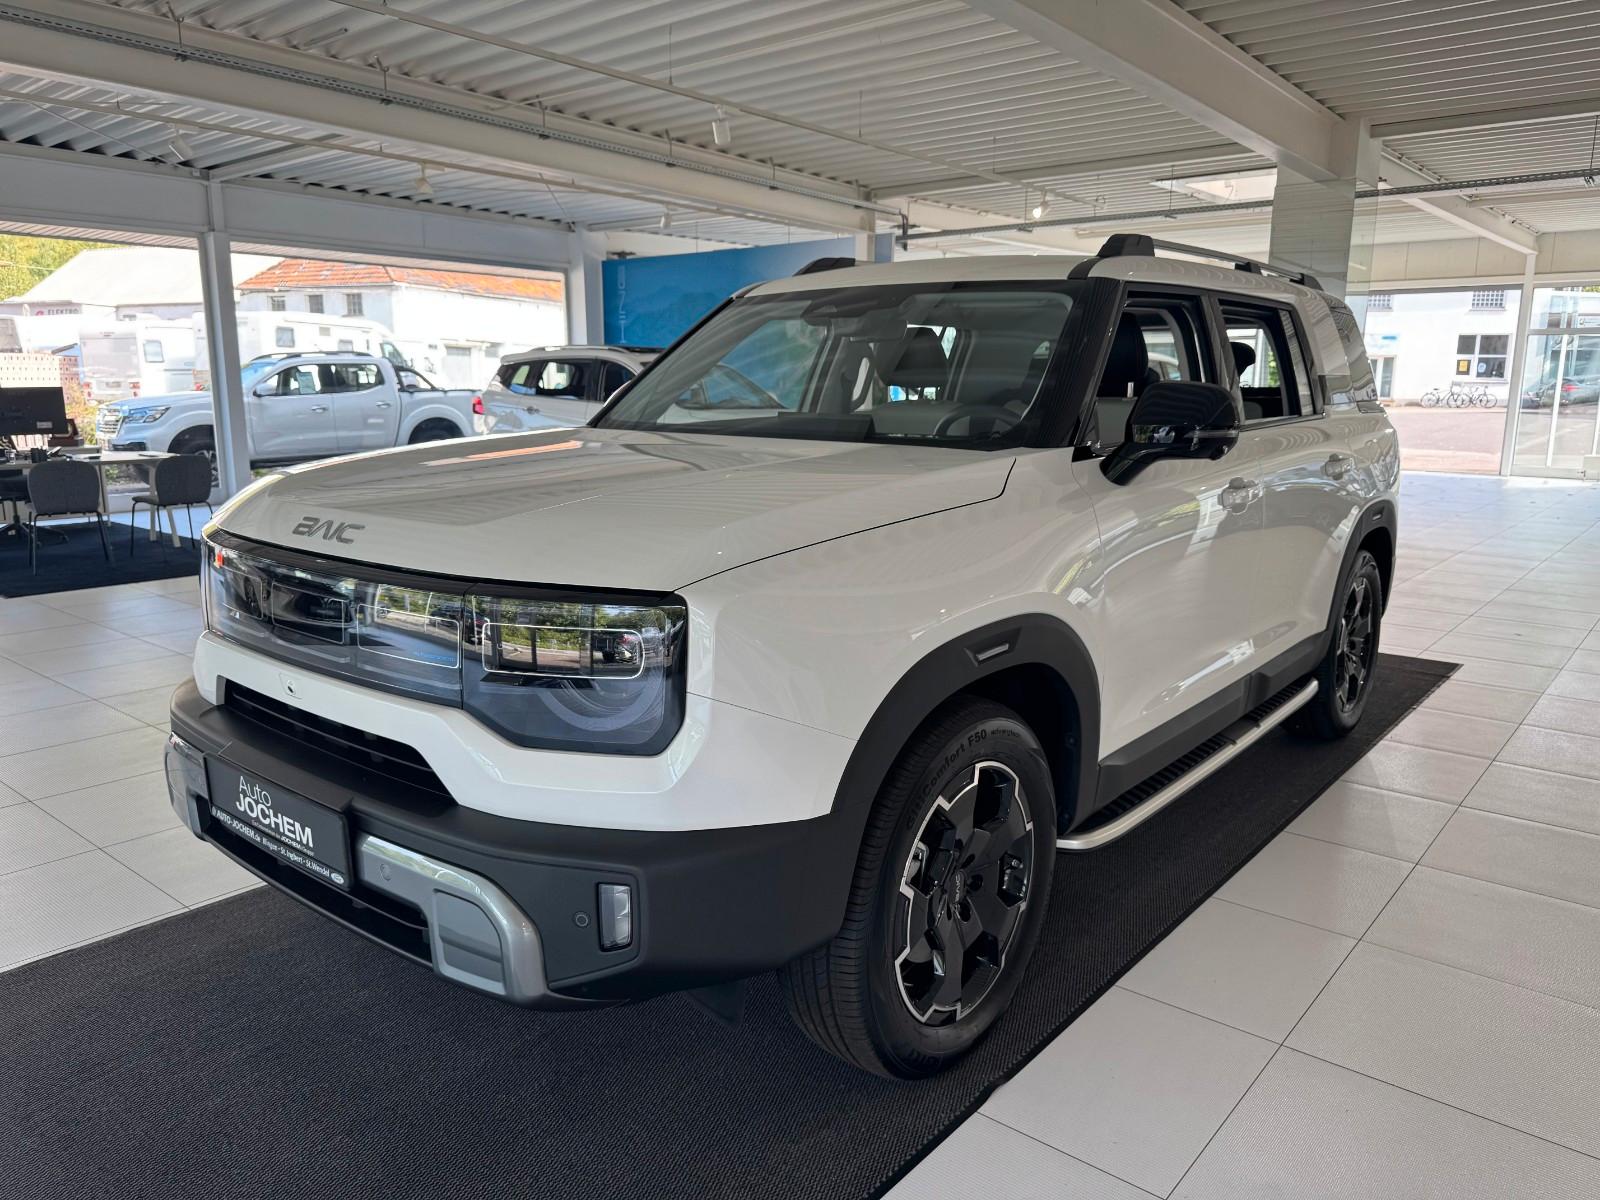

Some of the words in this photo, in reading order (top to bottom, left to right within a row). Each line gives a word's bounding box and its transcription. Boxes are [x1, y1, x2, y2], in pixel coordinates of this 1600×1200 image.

[967, 728, 989, 747] F50
[239, 775, 272, 807] Auto
[236, 794, 314, 848] JOCHEM
